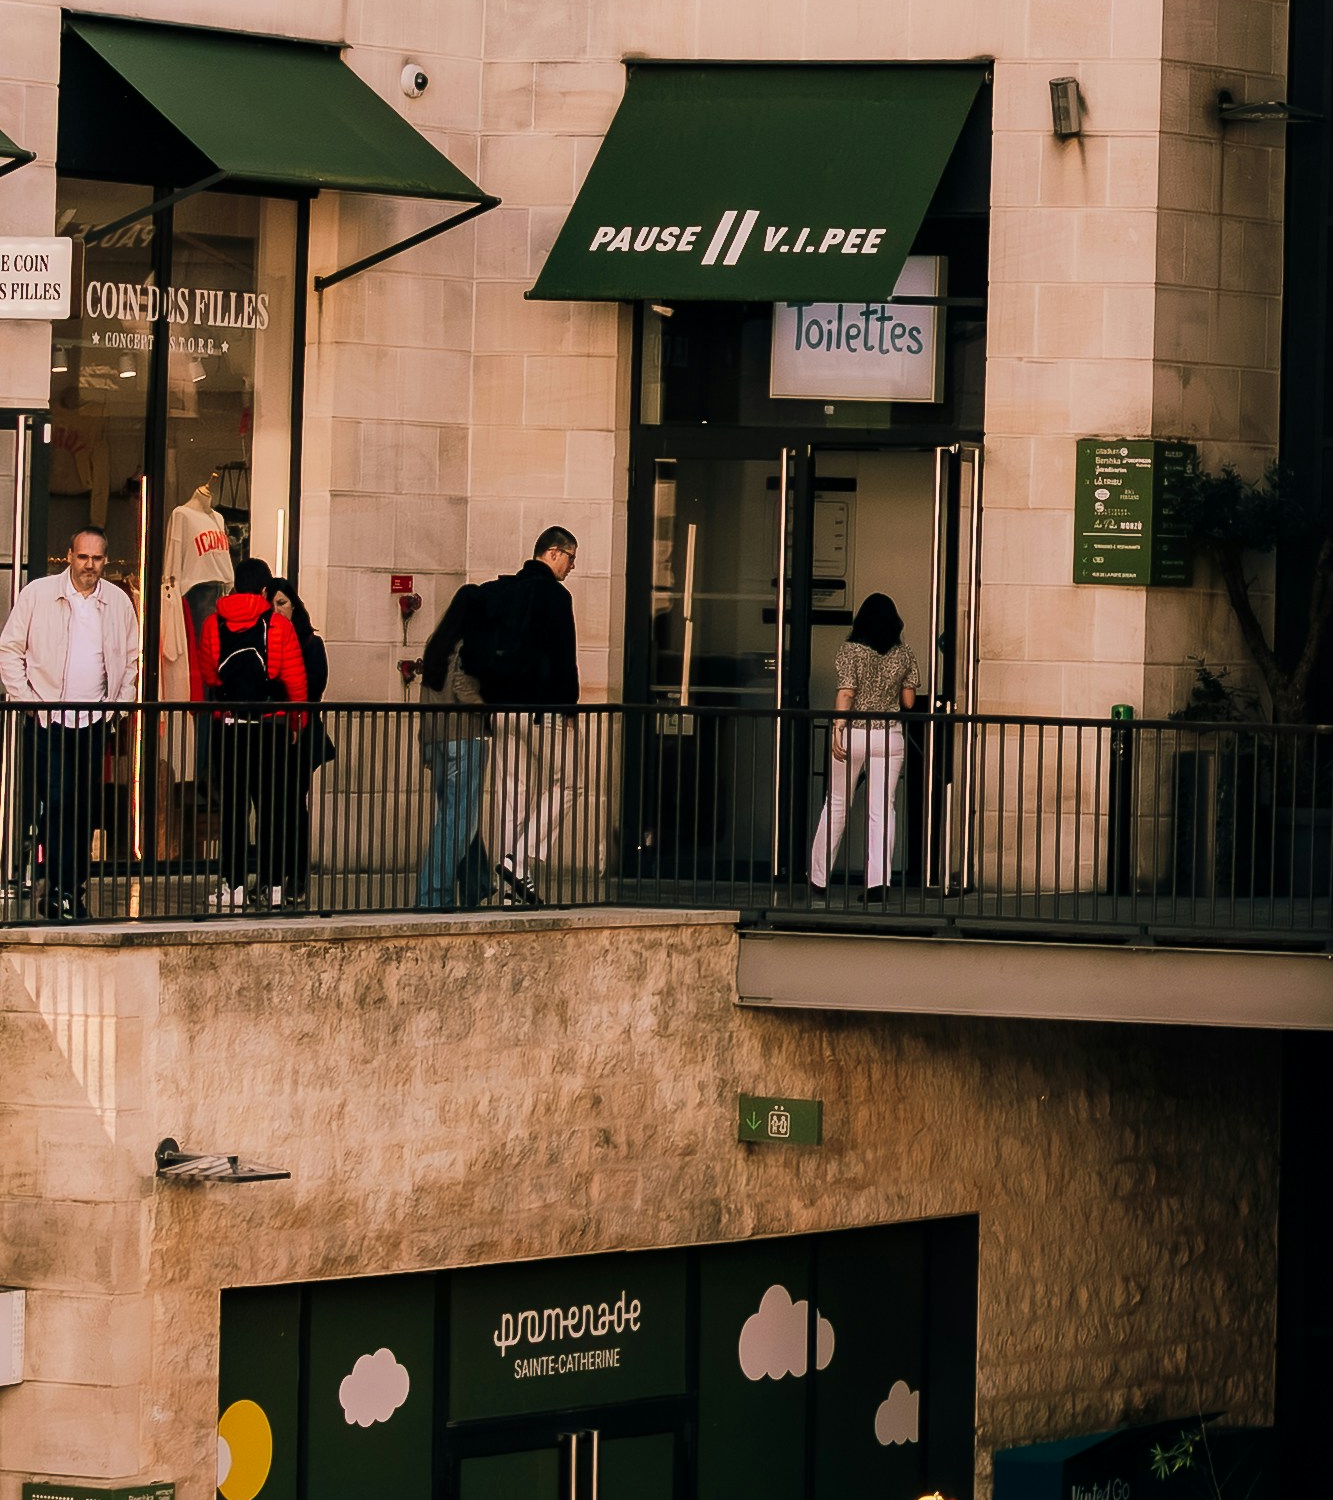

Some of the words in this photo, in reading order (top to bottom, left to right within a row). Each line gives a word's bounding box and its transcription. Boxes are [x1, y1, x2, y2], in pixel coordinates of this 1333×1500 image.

[590, 226, 702, 252] PAUSE
[763, 226, 887, 254] V.I.PEE
[14, 254, 49, 272] COIN
[11, 282, 61, 300] FILLES
[87, 281, 141, 320] COIN
[194, 289, 269, 330] FILLES
[105, 332, 154, 350] CONCEPT
[170, 336, 214, 354] STORE
[786, 302, 924, 355] Toilettes
[493, 1290, 641, 1357] promenade
[514, 1348, 620, 1378] SAINTE-CATHERINE
